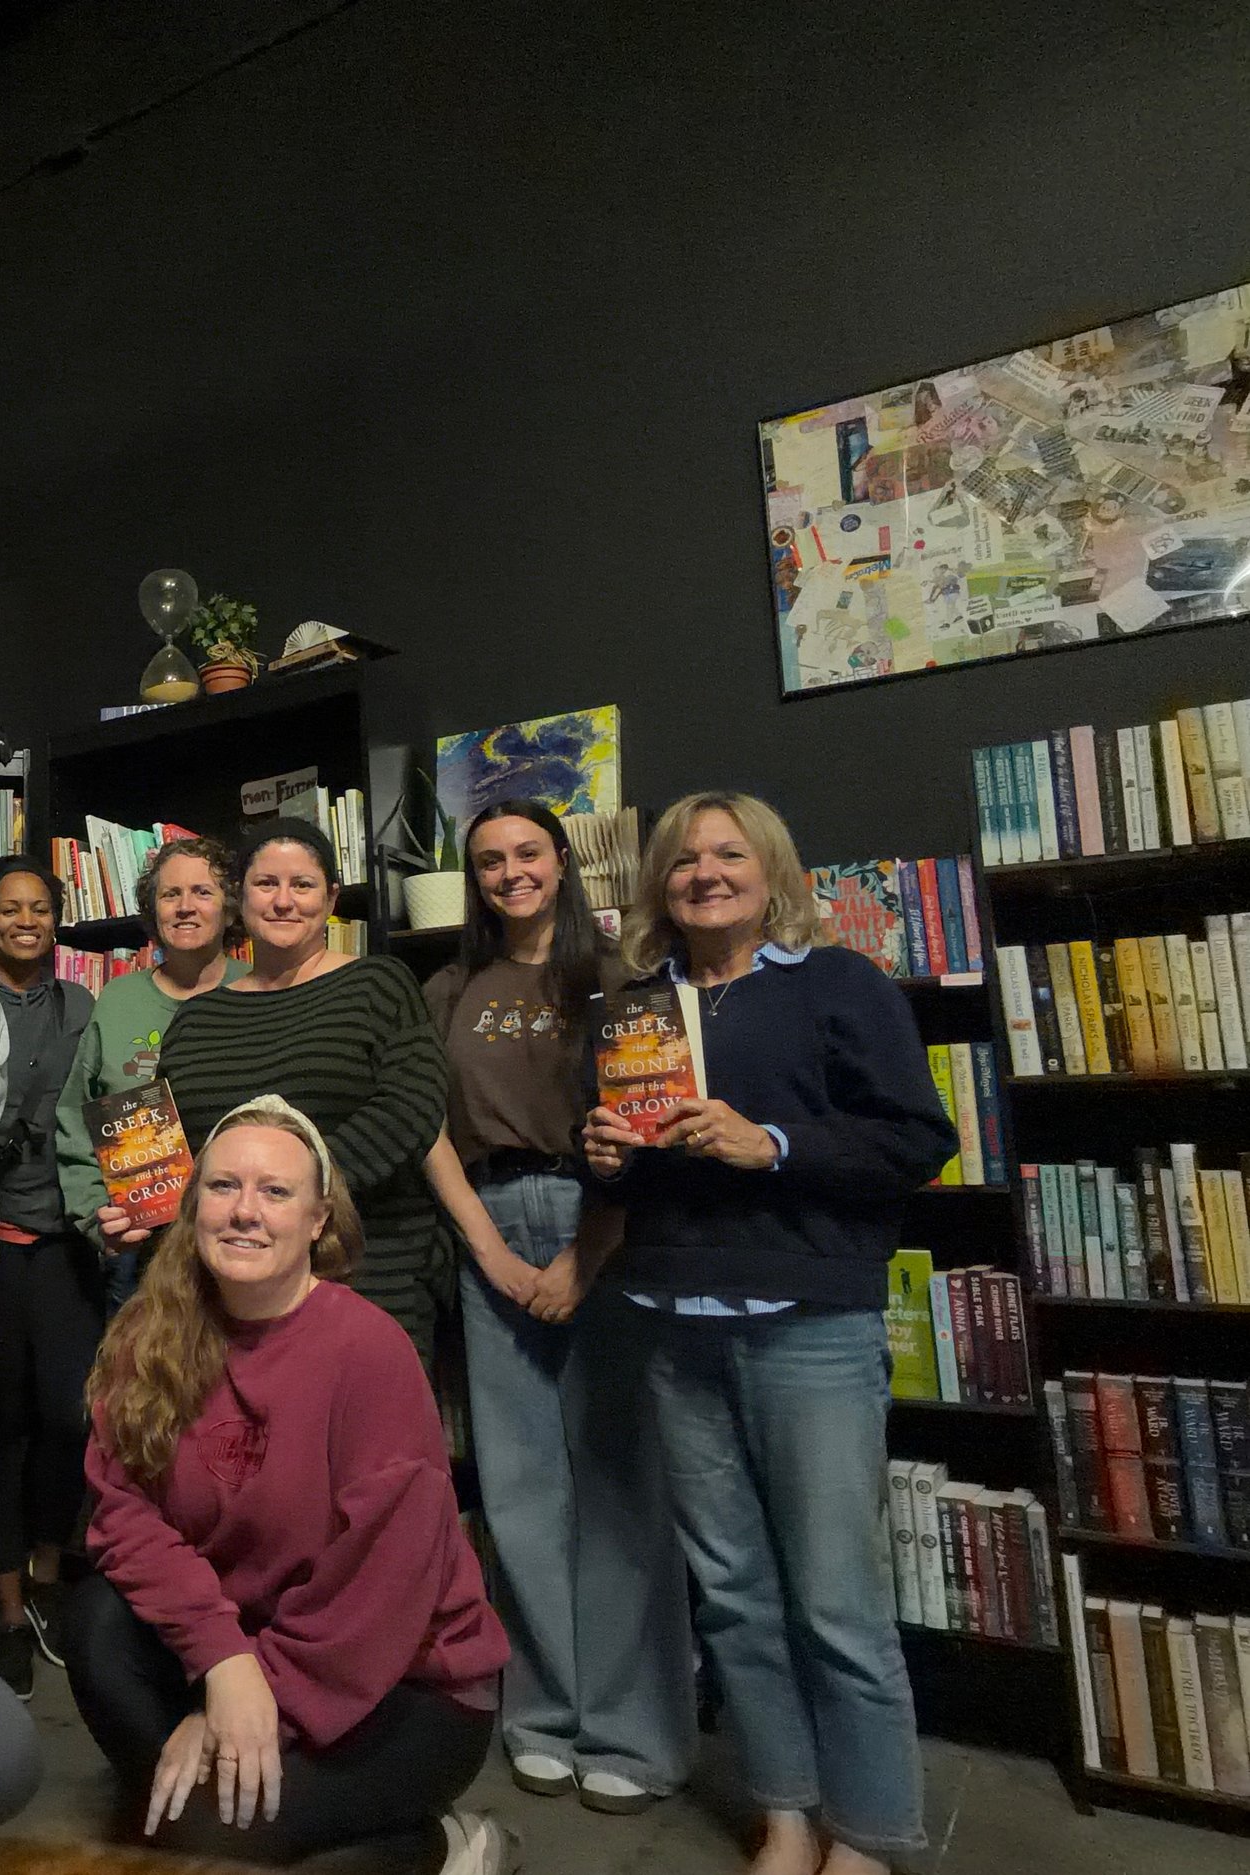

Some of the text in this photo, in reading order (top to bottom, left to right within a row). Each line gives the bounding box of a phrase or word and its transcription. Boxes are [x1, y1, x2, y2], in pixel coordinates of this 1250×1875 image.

[914, 953, 926, 967] You
[627, 1003, 643, 1014] the
[1077, 957, 1097, 1038] NICHOLAS SPARKS
[602, 1016, 677, 1039] CREEK,
[632, 1044, 648, 1052] the
[605, 1055, 686, 1078] CRONE,
[627, 1081, 666, 1093] and the
[980, 1068, 992, 1097] Moyes
[123, 1101, 137, 1111] the
[618, 1096, 682, 1116] CROW
[101, 1108, 169, 1137] CREEK,
[134, 1135, 147, 1144] the
[110, 1141, 183, 1172] CRONE,
[135, 1166, 169, 1182] and the
[128, 1176, 183, 1203] CROW
[970, 1277, 984, 1327] SABLE PEAK
[1006, 1282, 1020, 1340] GARNET FLATS
[953, 1299, 965, 1333] ANNA
[994, 1318, 1003, 1340] RIVER
[1146, 1406, 1159, 1437] WARD
[1215, 1411, 1233, 1450] WARD
[1167, 1482, 1181, 1517] LOVER
